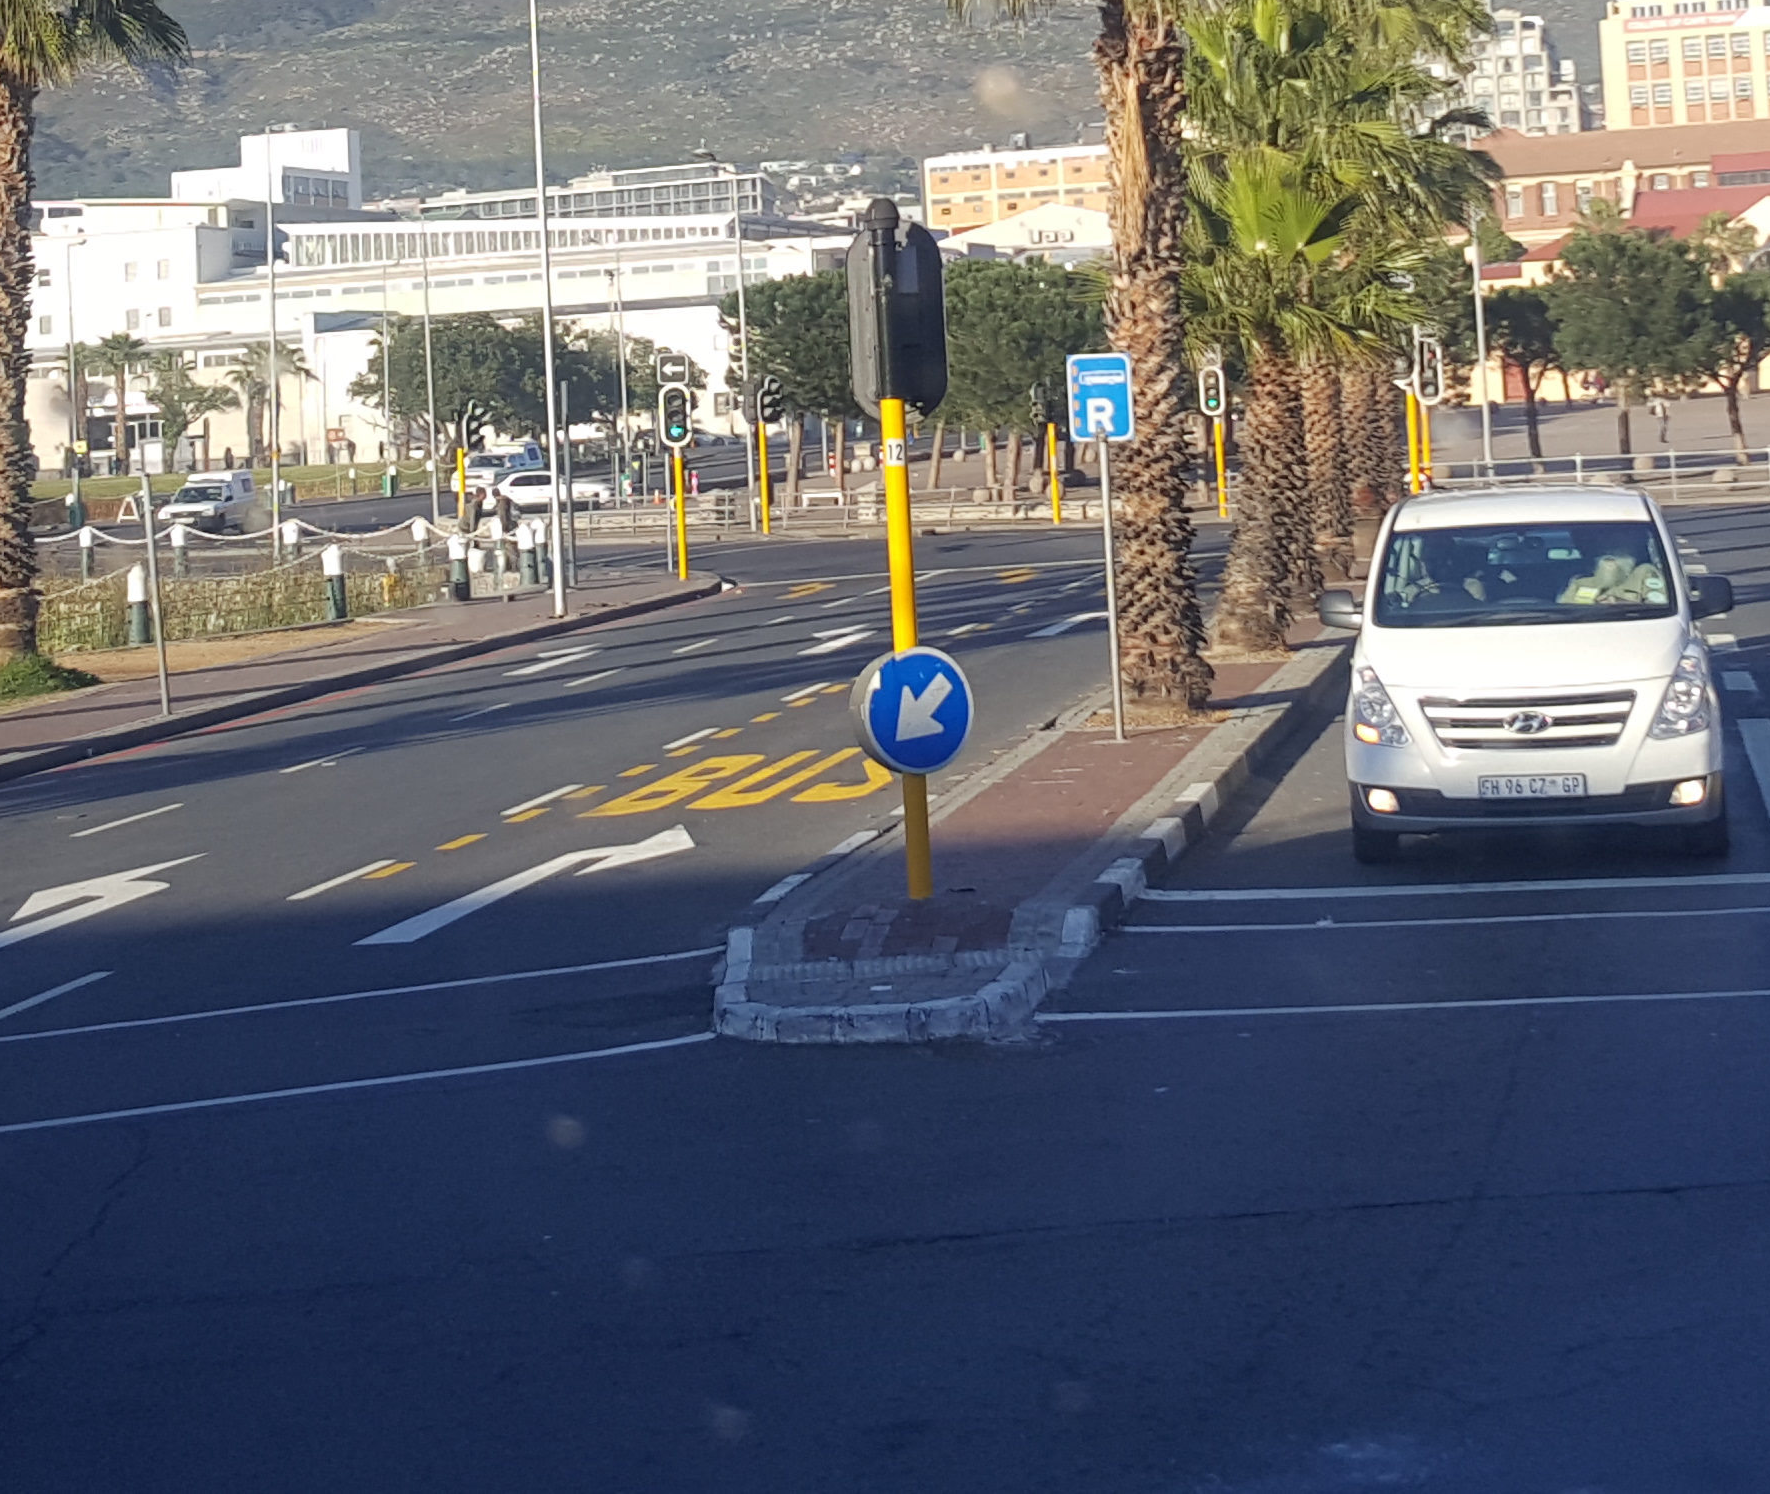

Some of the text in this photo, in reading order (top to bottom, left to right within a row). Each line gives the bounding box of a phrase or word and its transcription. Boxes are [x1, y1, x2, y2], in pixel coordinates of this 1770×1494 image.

[1086, 397, 1115, 434] R
[887, 443, 903, 461] 12
[1504, 778, 1524, 795] 96
[1561, 776, 1580, 794] GP
